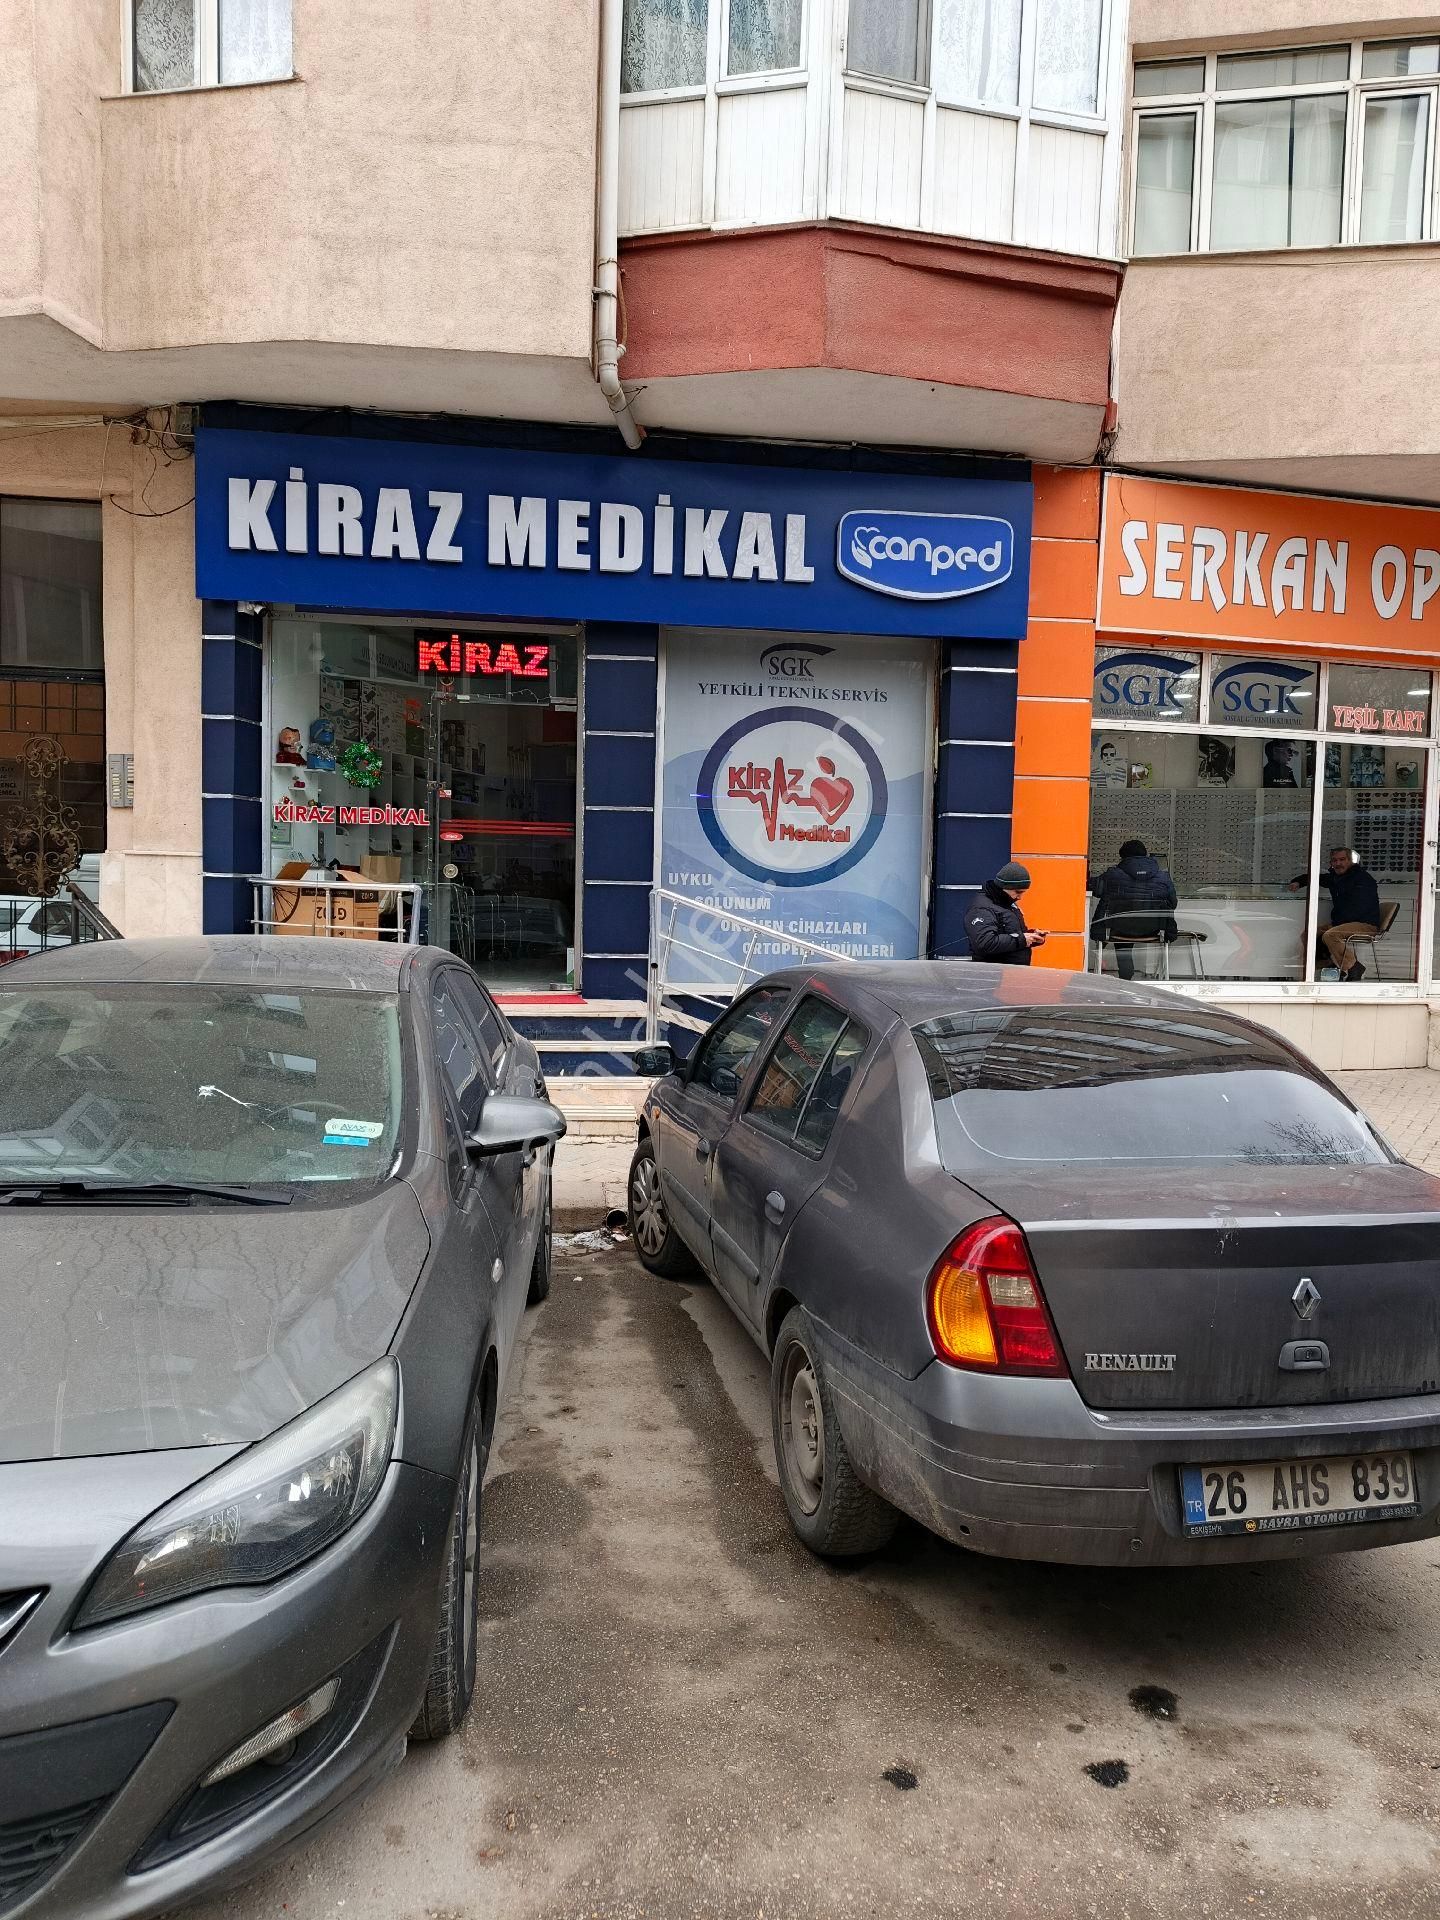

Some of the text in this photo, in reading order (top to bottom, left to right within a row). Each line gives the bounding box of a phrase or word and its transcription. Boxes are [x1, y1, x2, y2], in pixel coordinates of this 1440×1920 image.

[228, 467, 815, 583] KİRAZ MEDİKAL
[868, 536, 1001, 576] canped
[1118, 520, 1440, 621] SERKAN OP
[418, 634, 549, 677] KİRAZ
[768, 656, 814, 677] SGK
[698, 681, 888, 703] YETKİLİ TEKNİK SERVİS
[1100, 673, 1184, 708] SGK
[1223, 681, 1303, 716] SGK
[1332, 703, 1425, 734] YEŞİL KART
[273, 801, 430, 826] KİRAZ MEDİKAL
[779, 824, 851, 843] Medikal
[668, 872, 712, 886] UYKU
[789, 917, 867, 935] CİHAZLARI
[1084, 1353, 1177, 1371] RENAULT
[1205, 1456, 1411, 1517] 26 AHS 839
[1187, 1500, 1203, 1513] TR
[1258, 1516, 1300, 1530] KAYRA
